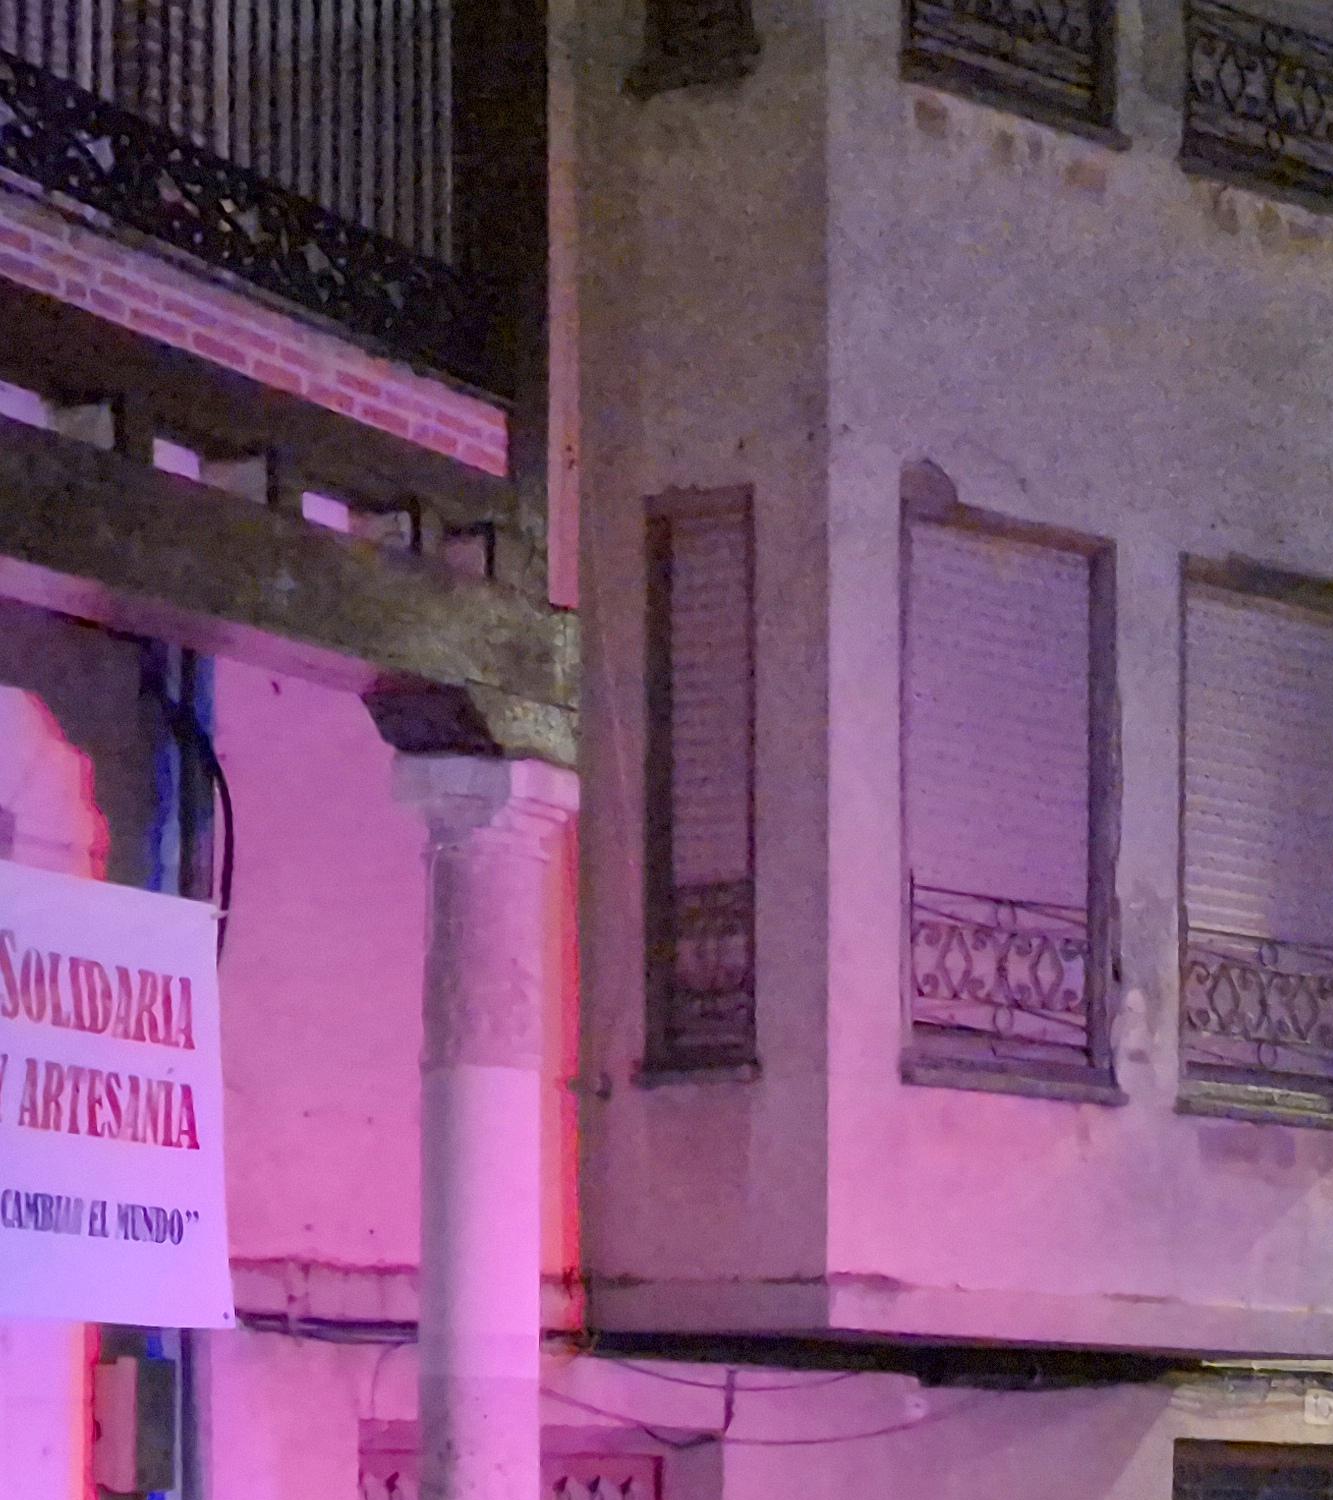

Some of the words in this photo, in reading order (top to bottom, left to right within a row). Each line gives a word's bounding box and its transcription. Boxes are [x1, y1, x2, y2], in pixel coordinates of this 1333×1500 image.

[0, 929, 195, 1050] SOLIDARIA
[18, 1055, 200, 1150] ARTESANÍA
[88, 1199, 109, 1238] EL
